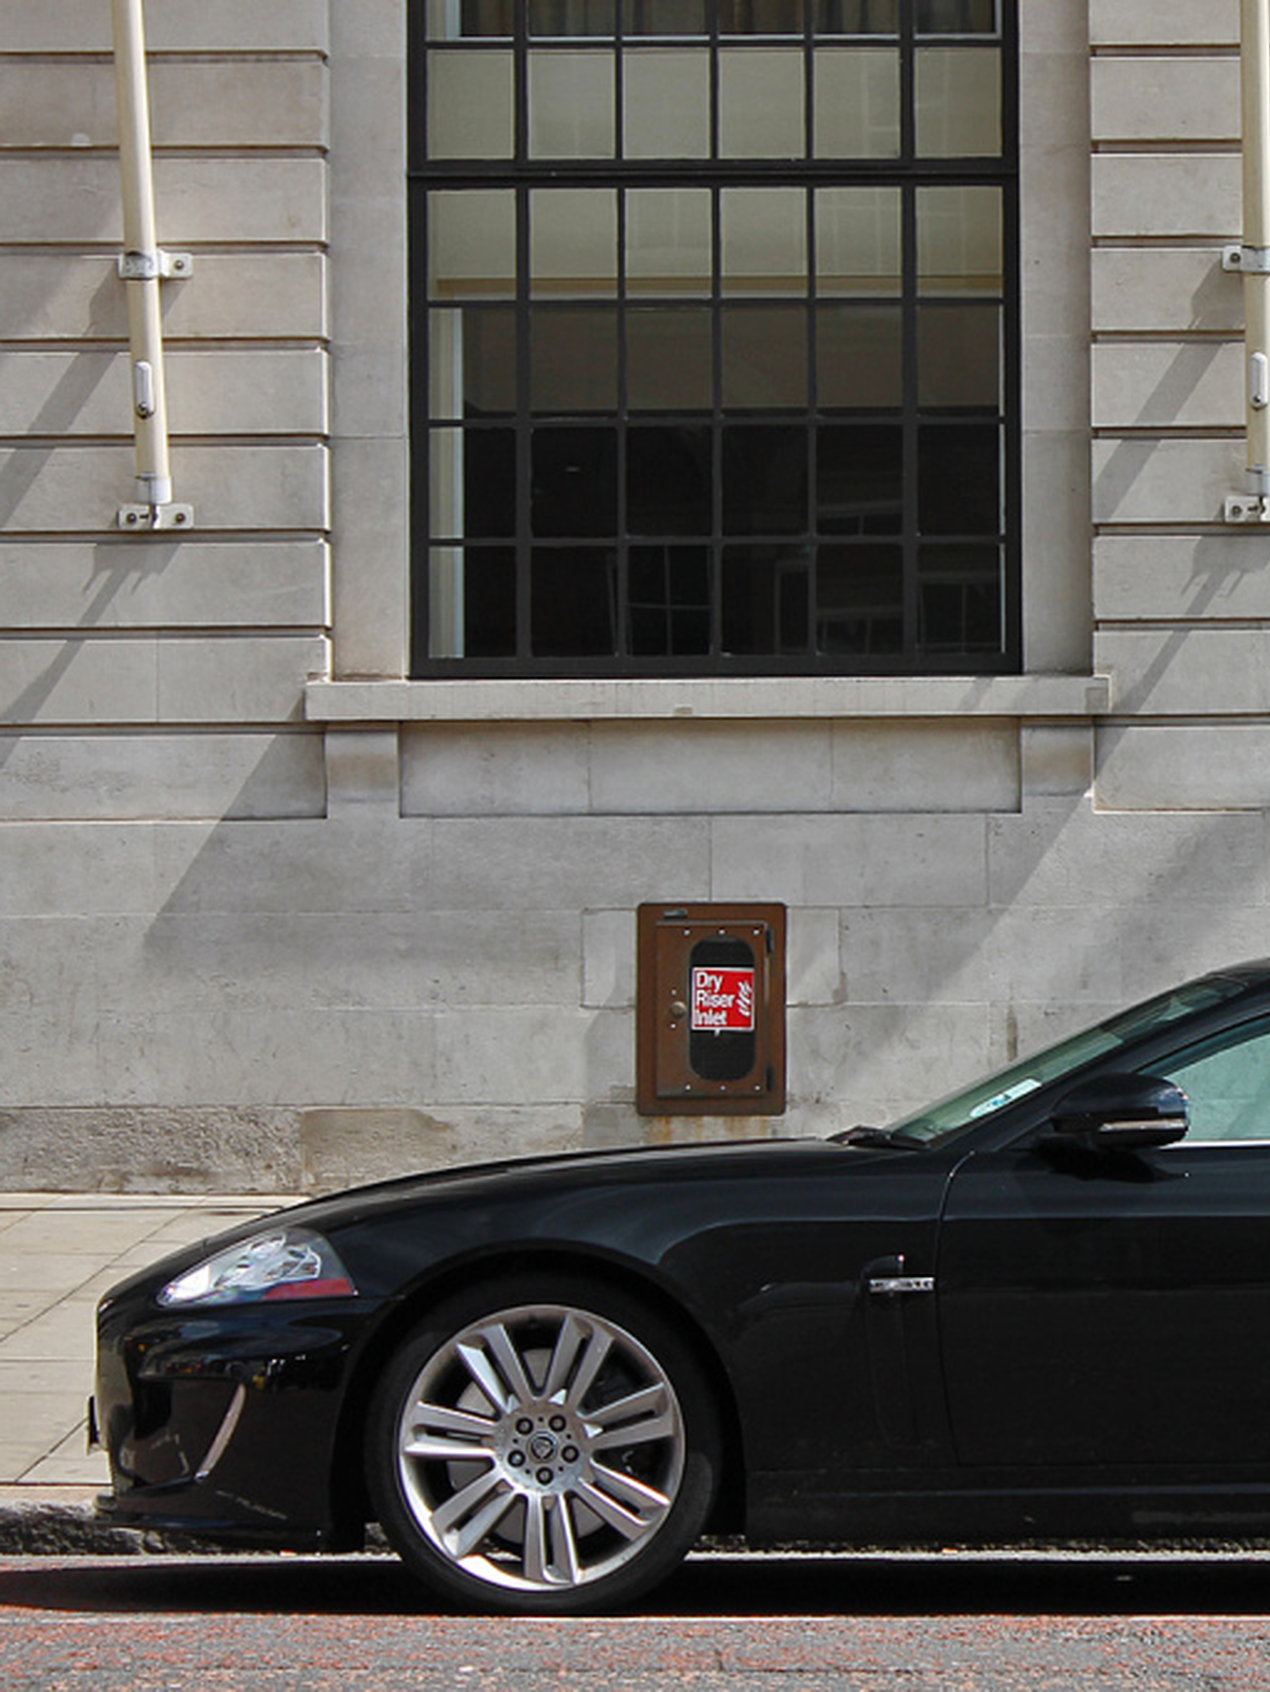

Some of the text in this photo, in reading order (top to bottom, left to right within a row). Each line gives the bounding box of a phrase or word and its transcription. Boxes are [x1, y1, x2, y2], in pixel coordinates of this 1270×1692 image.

[696, 971, 724, 993] Dry
[696, 989, 735, 1008] Riser
[696, 1008, 727, 1025] Inlet
